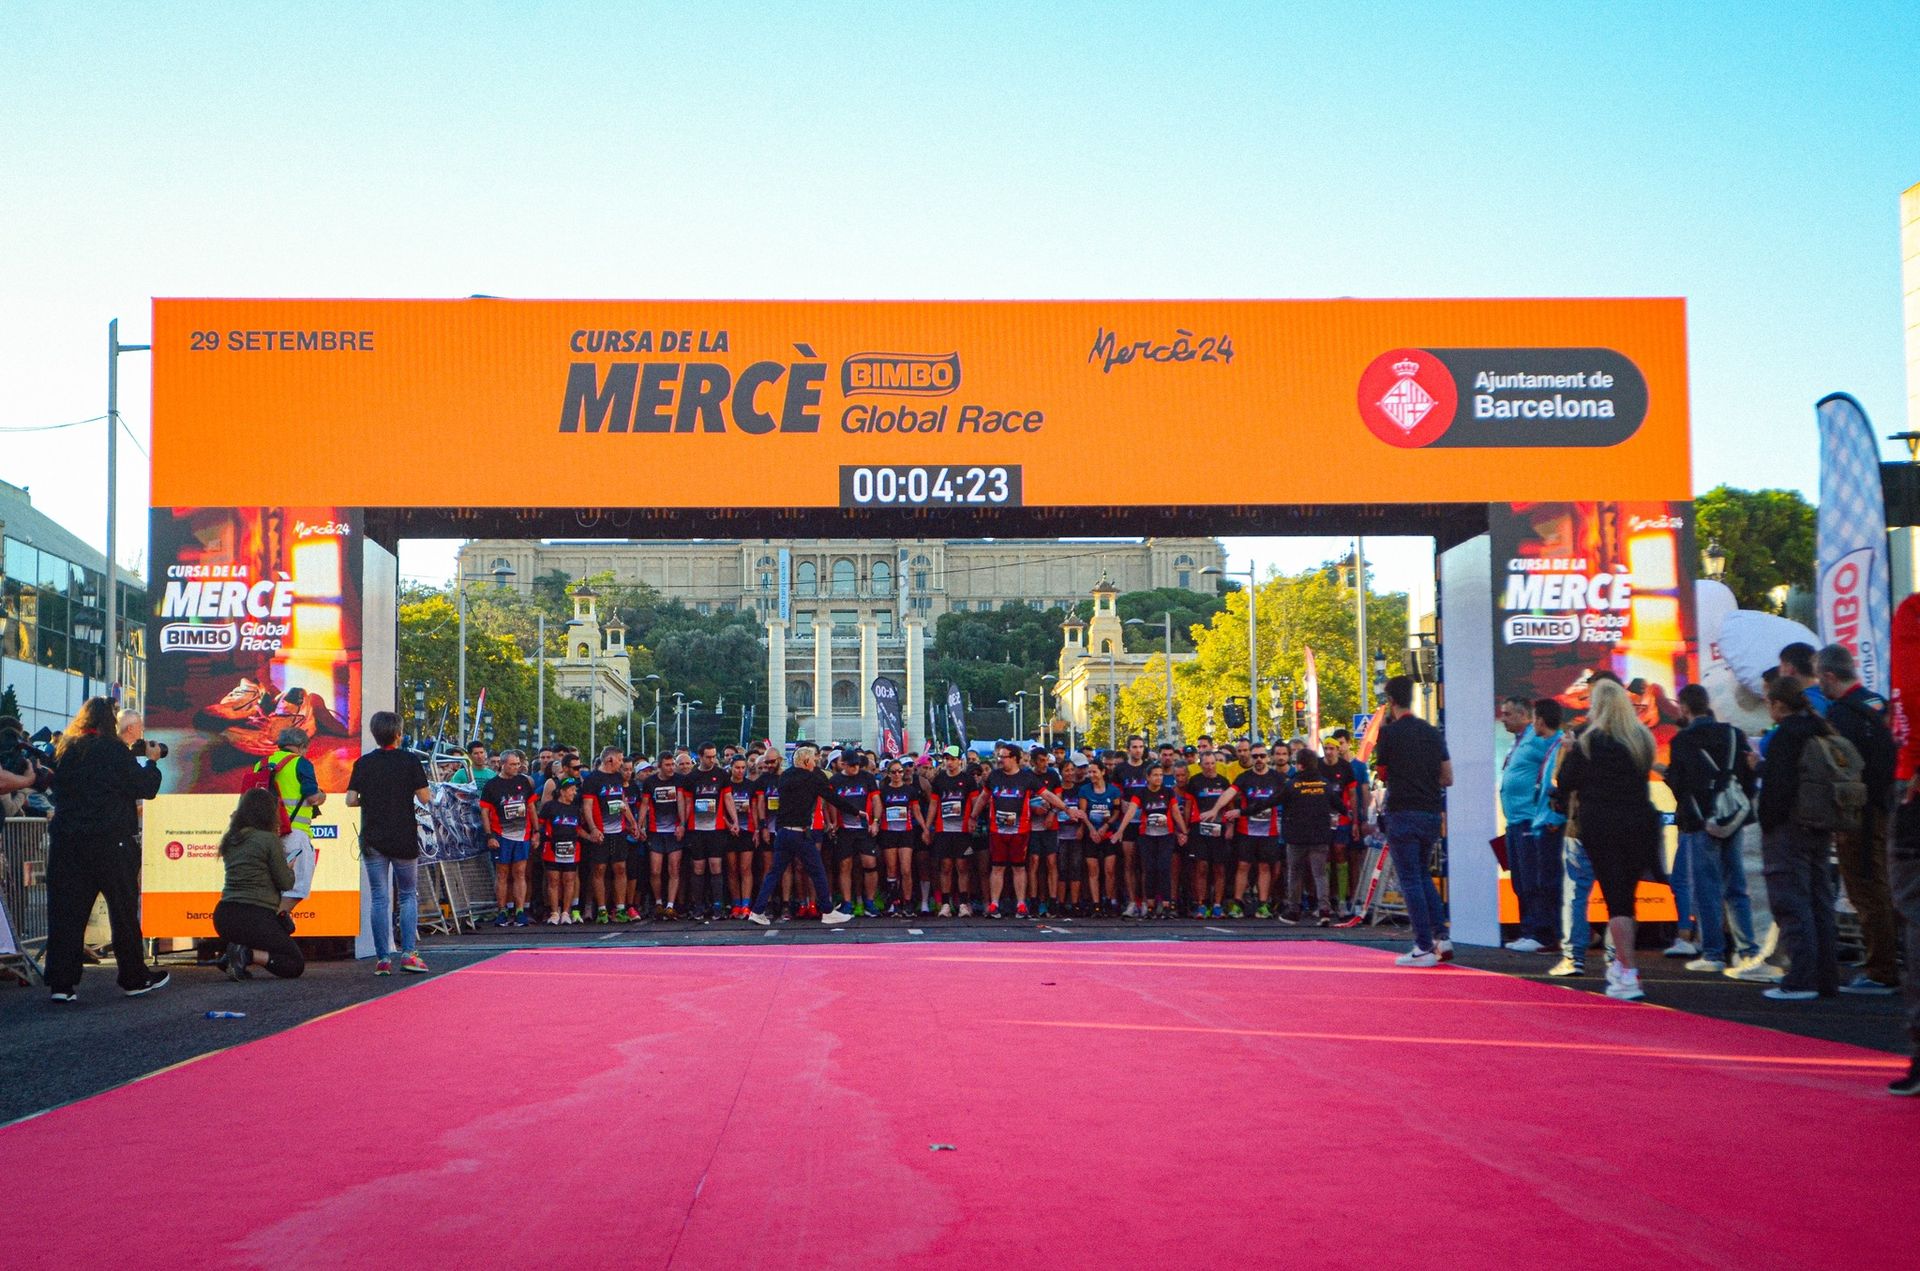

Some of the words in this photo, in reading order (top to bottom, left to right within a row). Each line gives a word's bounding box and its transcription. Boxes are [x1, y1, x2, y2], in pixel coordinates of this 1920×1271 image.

[189, 330, 219, 351] 29
[227, 330, 374, 351] SETEMBRE
[569, 330, 655, 353] CURSA
[659, 330, 693, 353] DE
[698, 330, 729, 353] LA
[849, 362, 954, 389] BIMBO
[1474, 370, 1586, 393] Ajuntament
[1589, 370, 1614, 389] de
[558, 342, 828, 436] MERCÈ
[1474, 394, 1616, 419] Barcelona
[840, 404, 947, 434] Global
[956, 405, 1044, 434] Race
[852, 467, 1009, 504] 00:04:23
[167, 565, 209, 578] CURSA
[212, 565, 229, 578] DE
[231, 565, 248, 578] LA
[1508, 558, 1550, 571] CURSA
[1552, 558, 1569, 571] DE
[1571, 558, 1587, 571] LA
[160, 570, 294, 618] MERCÈ
[1505, 563, 1633, 611] MERCÈ
[240, 621, 291, 636] Global
[1512, 621, 1574, 636] BIMBO
[1581, 613, 1631, 628] Global
[166, 629, 231, 645] BIMBO
[240, 636, 281, 651] Race
[1582, 628, 1622, 642] Race
